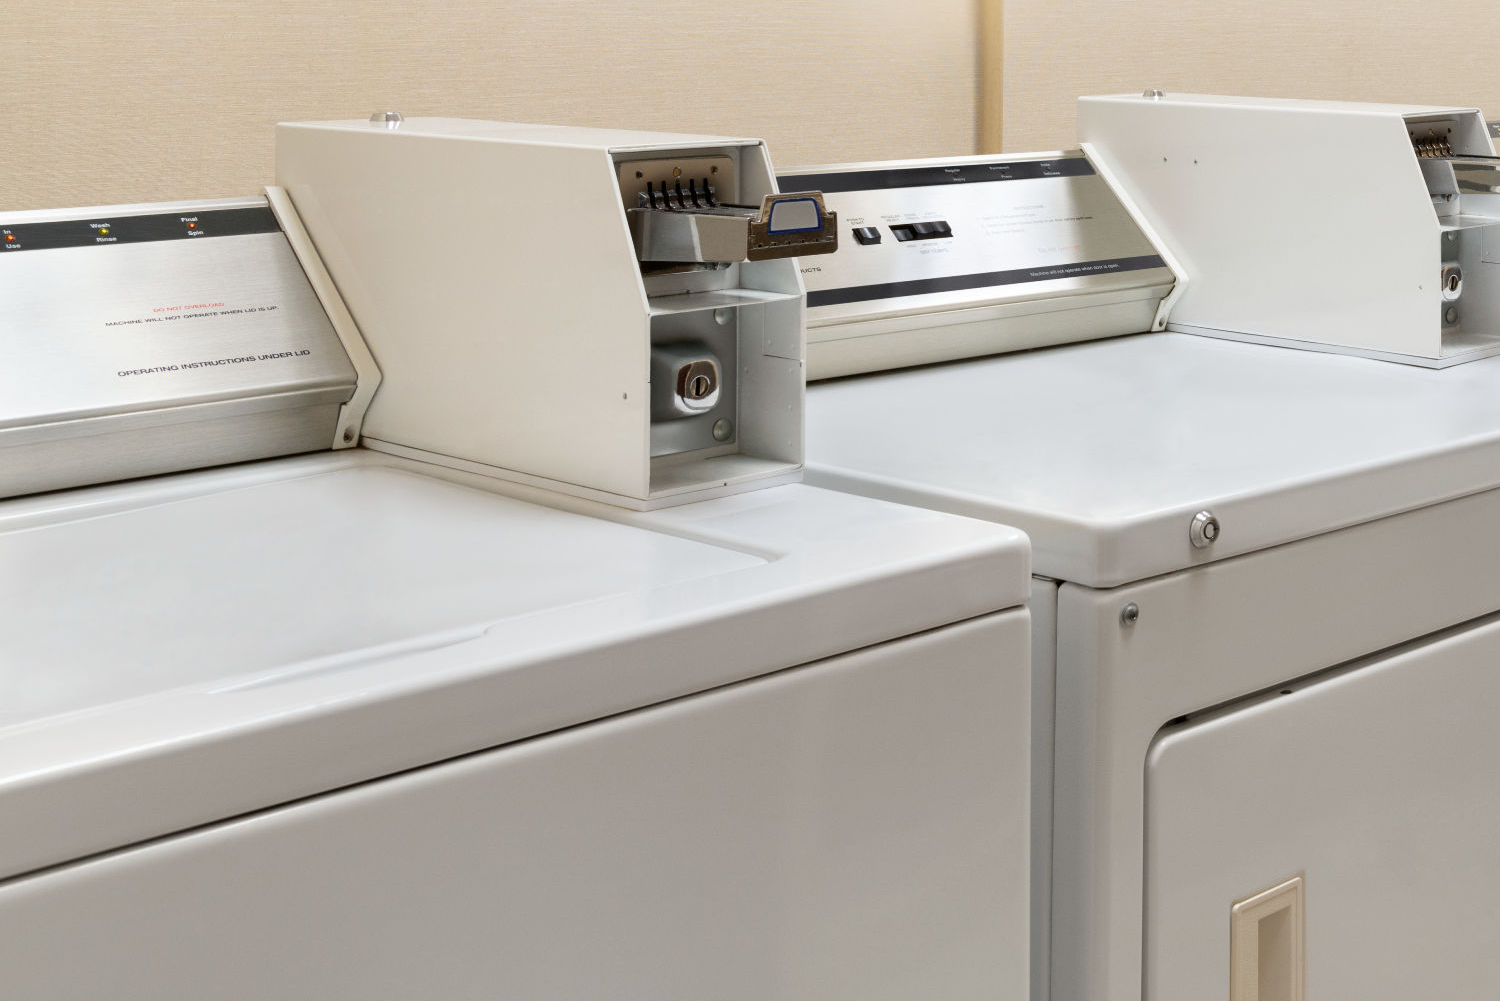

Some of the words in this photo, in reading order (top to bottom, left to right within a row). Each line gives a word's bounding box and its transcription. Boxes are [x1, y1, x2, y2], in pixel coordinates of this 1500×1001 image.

[184, 302, 225, 310] OVERLOAD
[105, 319, 143, 327] MACHINE
[183, 311, 218, 319] OPERATE
[117, 365, 179, 377] OPERATING
[181, 355, 257, 370] INSTRUCTIONS
[258, 351, 293, 361] UNDER
[294, 349, 311, 357] LID
